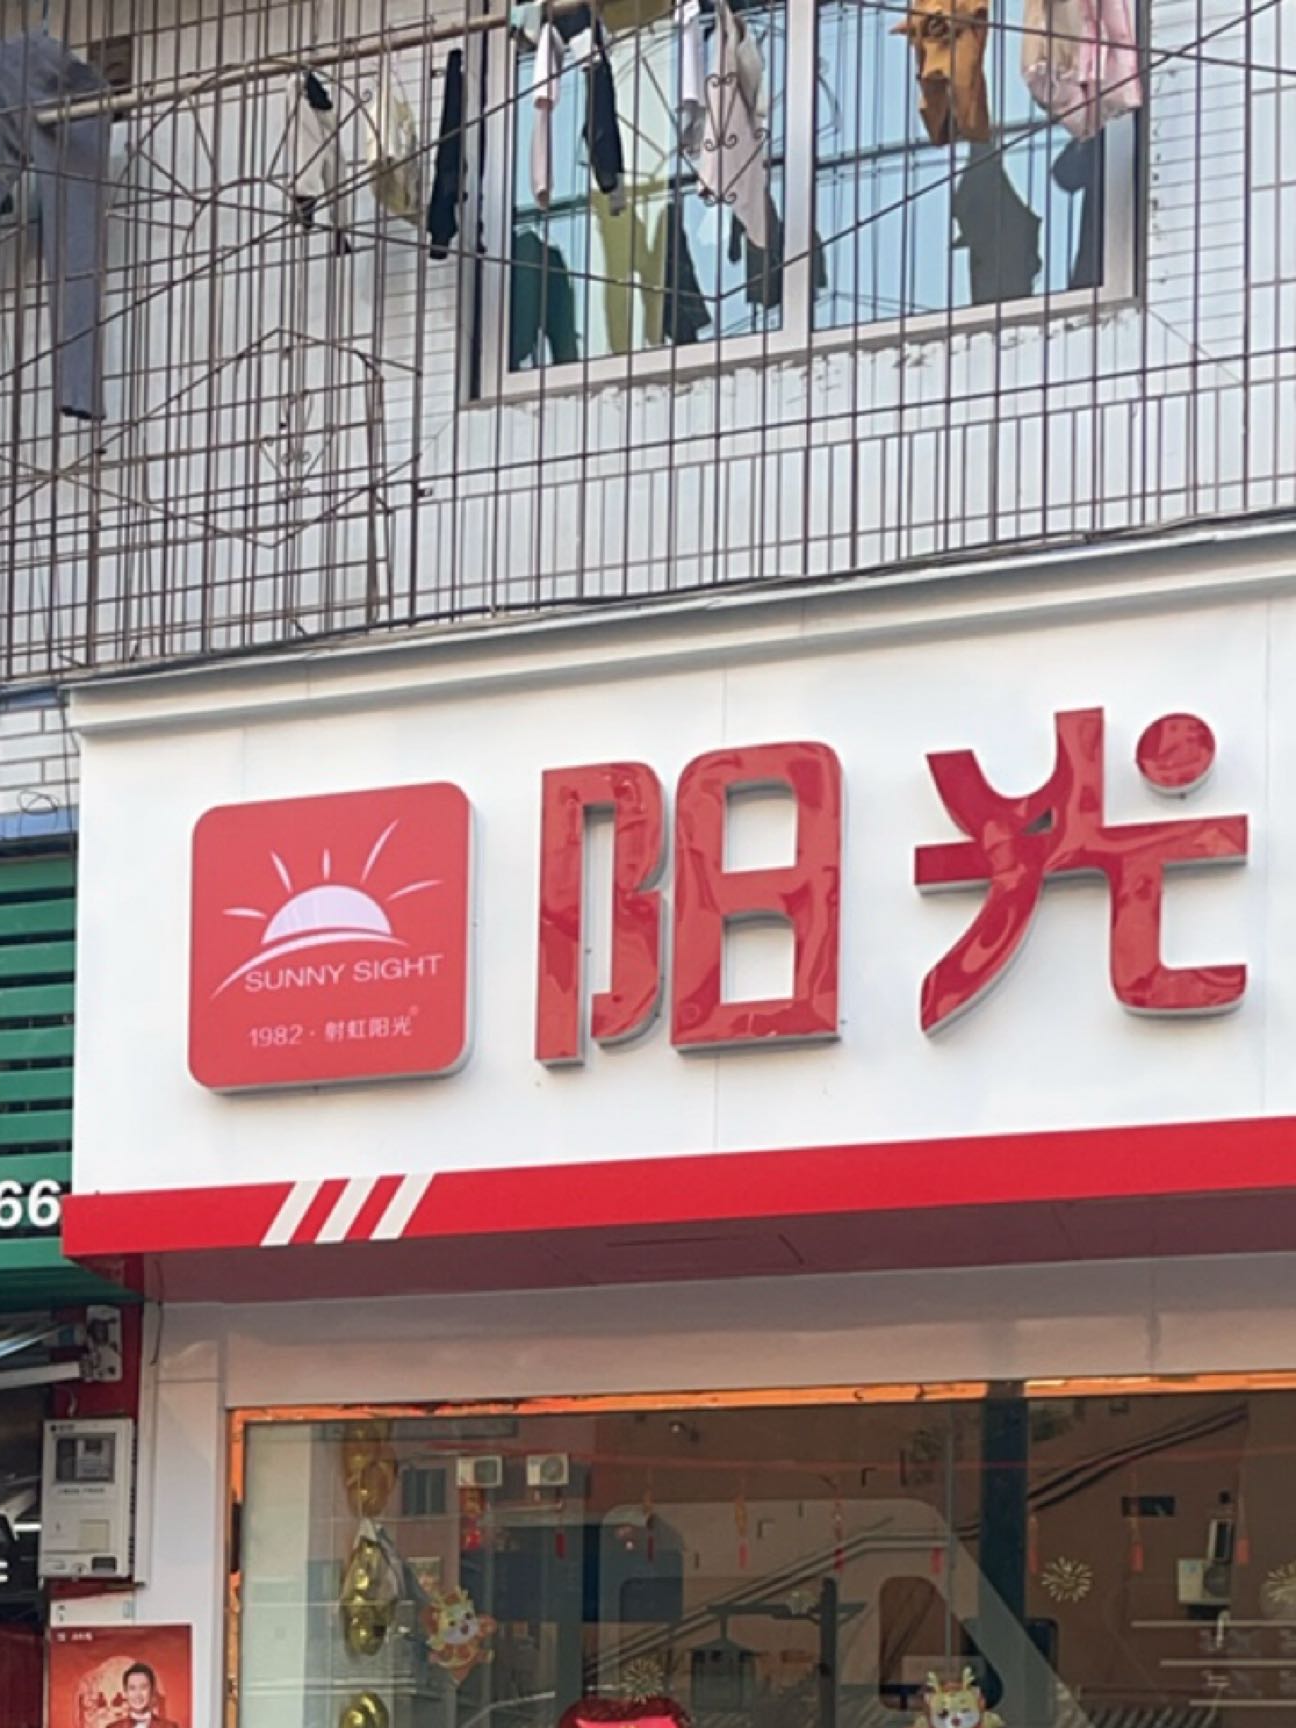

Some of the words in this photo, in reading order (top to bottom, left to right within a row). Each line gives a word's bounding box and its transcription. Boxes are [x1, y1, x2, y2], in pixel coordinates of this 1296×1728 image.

[245, 964, 345, 993] SUNNY
[353, 953, 444, 983] SIGHT
[535, 706, 1249, 1072] 阳光
